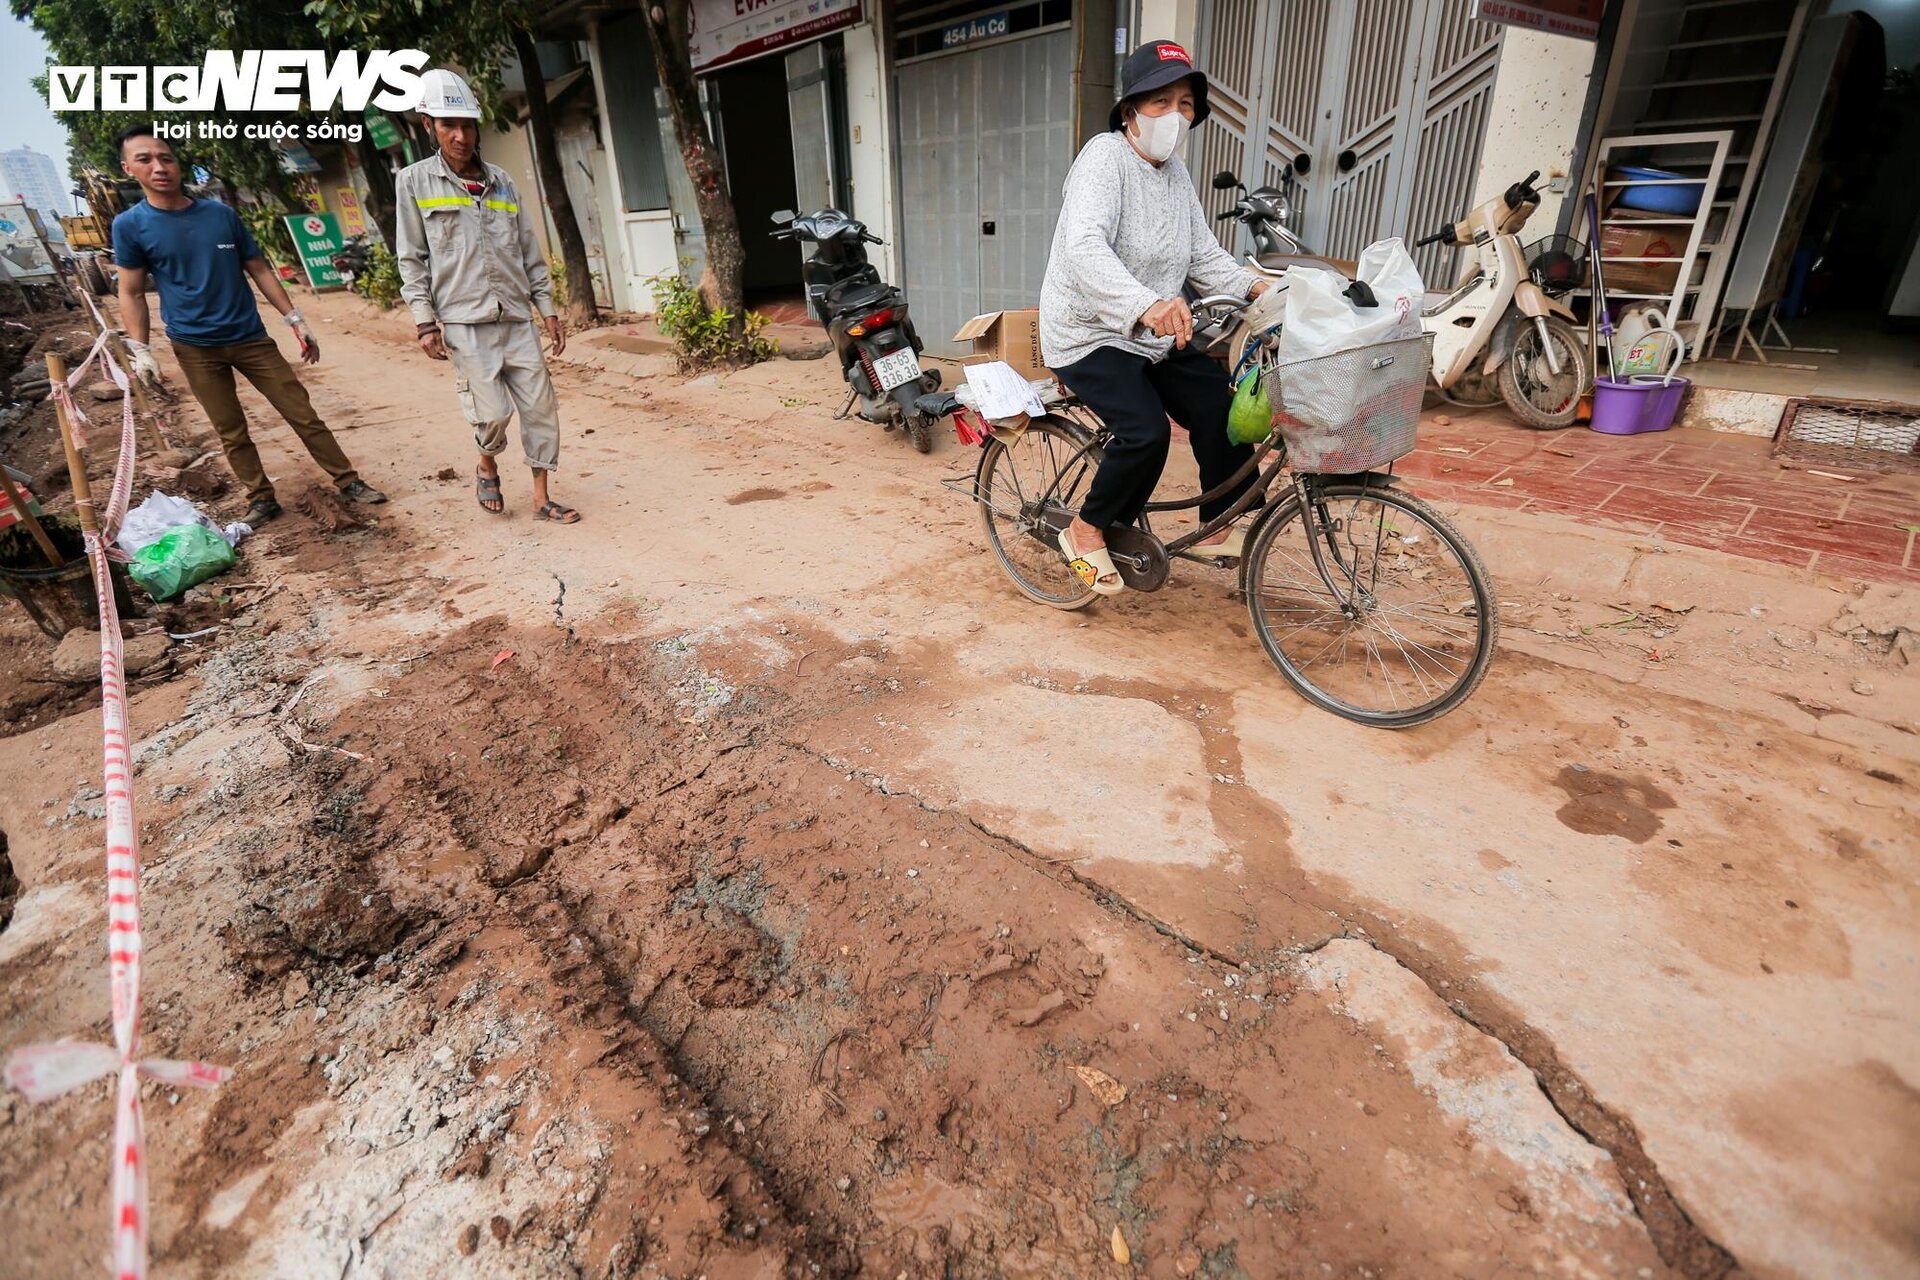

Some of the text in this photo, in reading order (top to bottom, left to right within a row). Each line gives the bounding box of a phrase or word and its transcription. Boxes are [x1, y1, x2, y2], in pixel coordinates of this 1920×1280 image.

[944, 27, 966, 44] 454
[880, 351, 910, 373] 36-G5
[883, 363, 919, 387] 336.38
